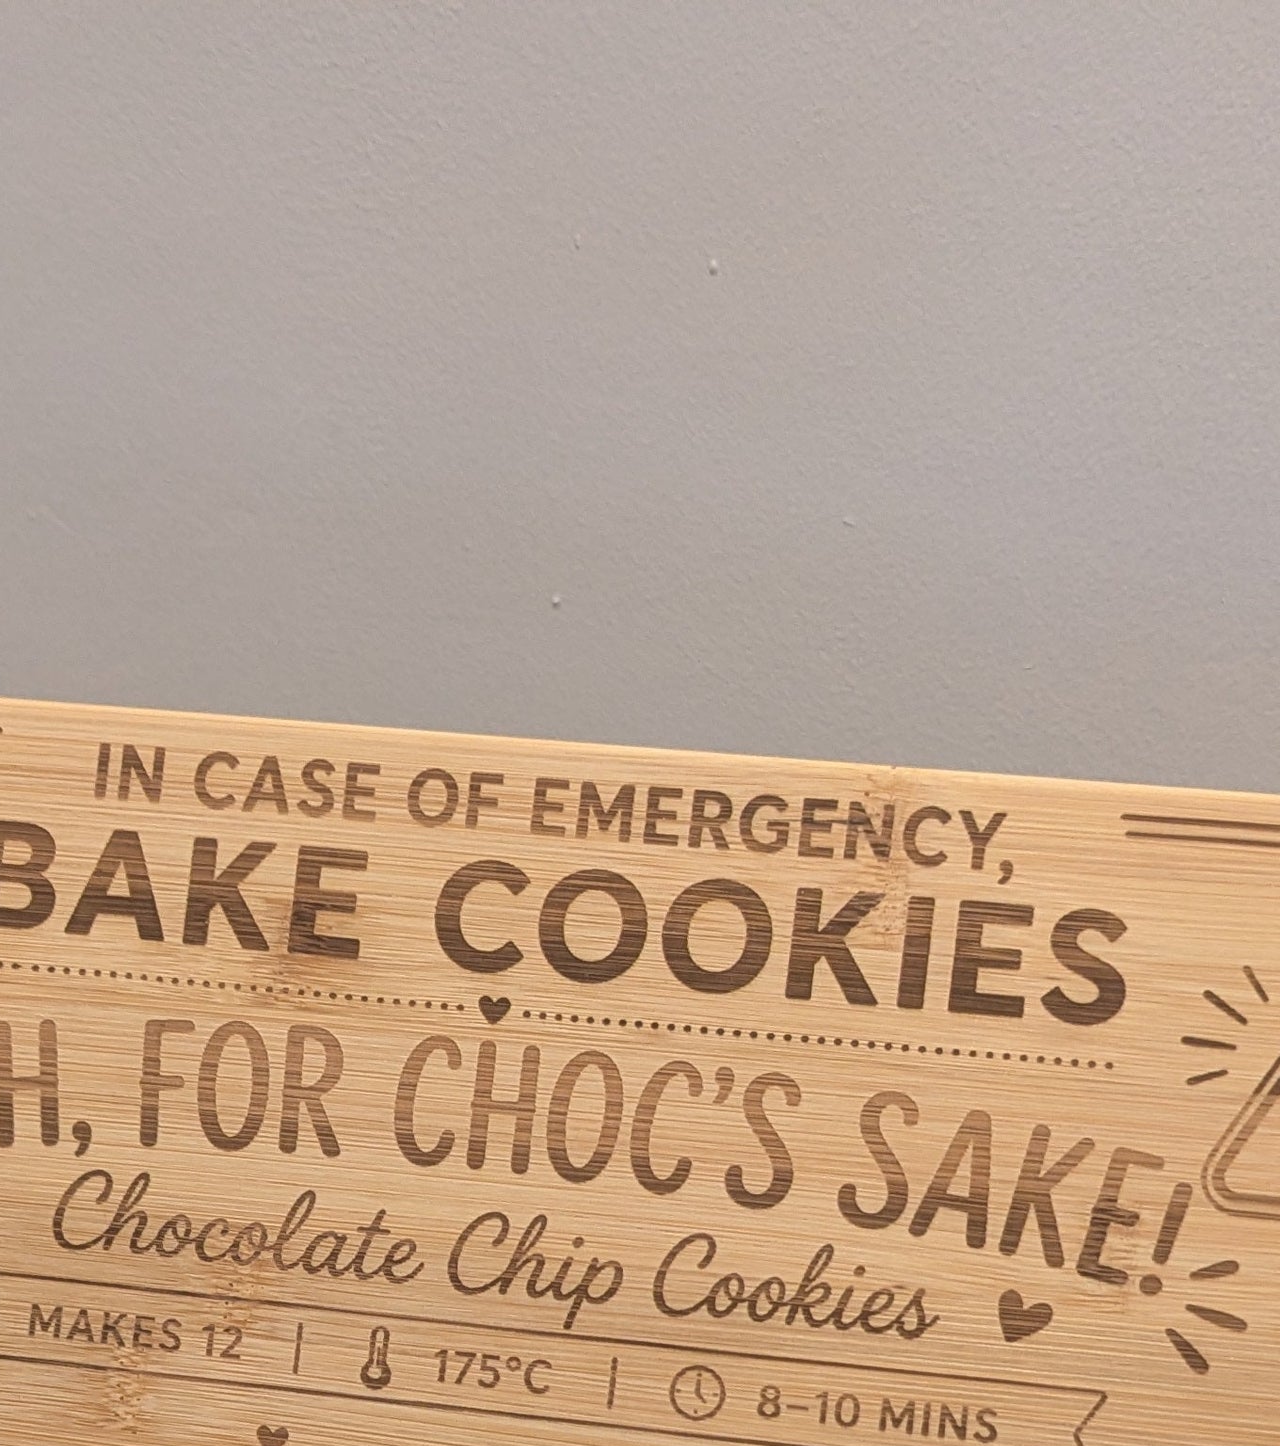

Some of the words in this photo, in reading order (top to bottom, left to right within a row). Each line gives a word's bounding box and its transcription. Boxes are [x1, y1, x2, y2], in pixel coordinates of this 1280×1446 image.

[94, 741, 165, 804] IN
[192, 751, 381, 822] CASE
[406, 769, 505, 830] OF
[529, 778, 1016, 884] EMERGENCY,
[434, 860, 1129, 1026] COOKIES
[138, 1018, 345, 1159] FOR
[836, 1089, 1194, 1298] SAKE!
[52, 1168, 426, 1284] Chocolate
[445, 1210, 624, 1329] Chip
[651, 1232, 939, 1341] Cookies
[25, 1304, 185, 1359] MAKES
[198, 1318, 246, 1362] 12
[432, 1346, 554, 1398] 175°C
[878, 1395, 1000, 1446] MINS
